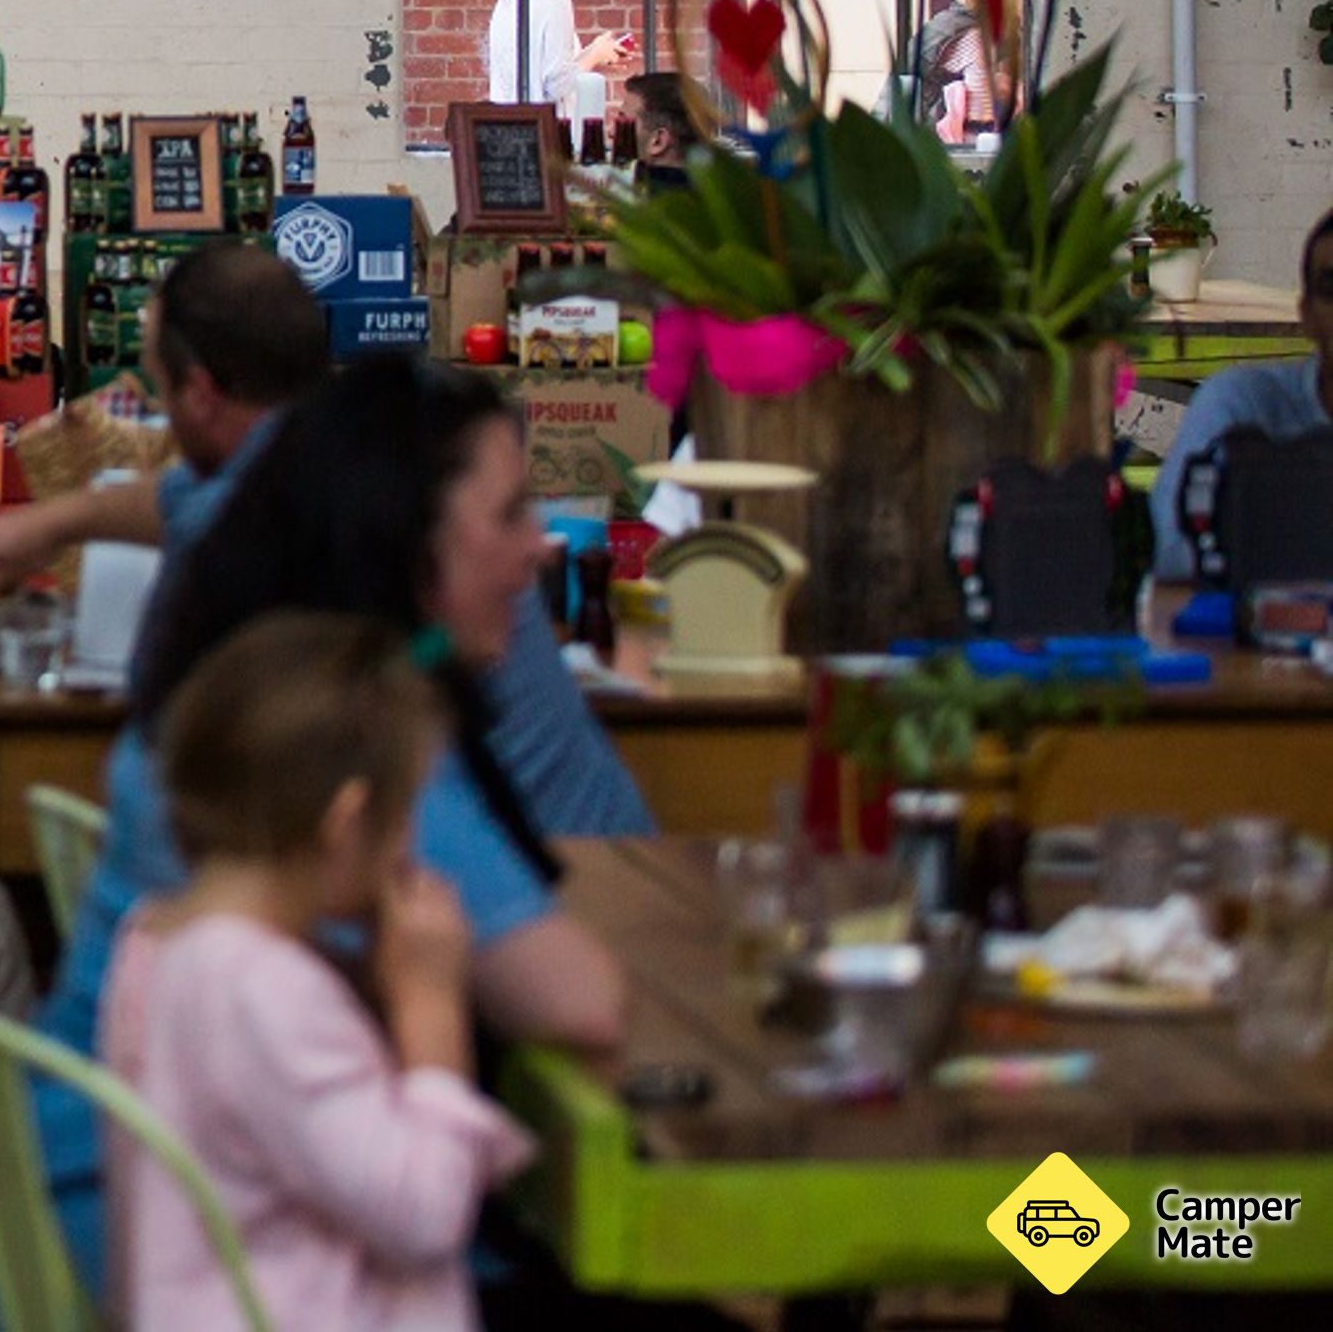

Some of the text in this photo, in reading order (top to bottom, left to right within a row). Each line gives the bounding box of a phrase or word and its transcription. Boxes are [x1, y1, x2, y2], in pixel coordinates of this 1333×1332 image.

[283, 217, 337, 242] FURPHY
[364, 312, 427, 330] FURPH
[526, 401, 618, 424] IPSQUEAK
